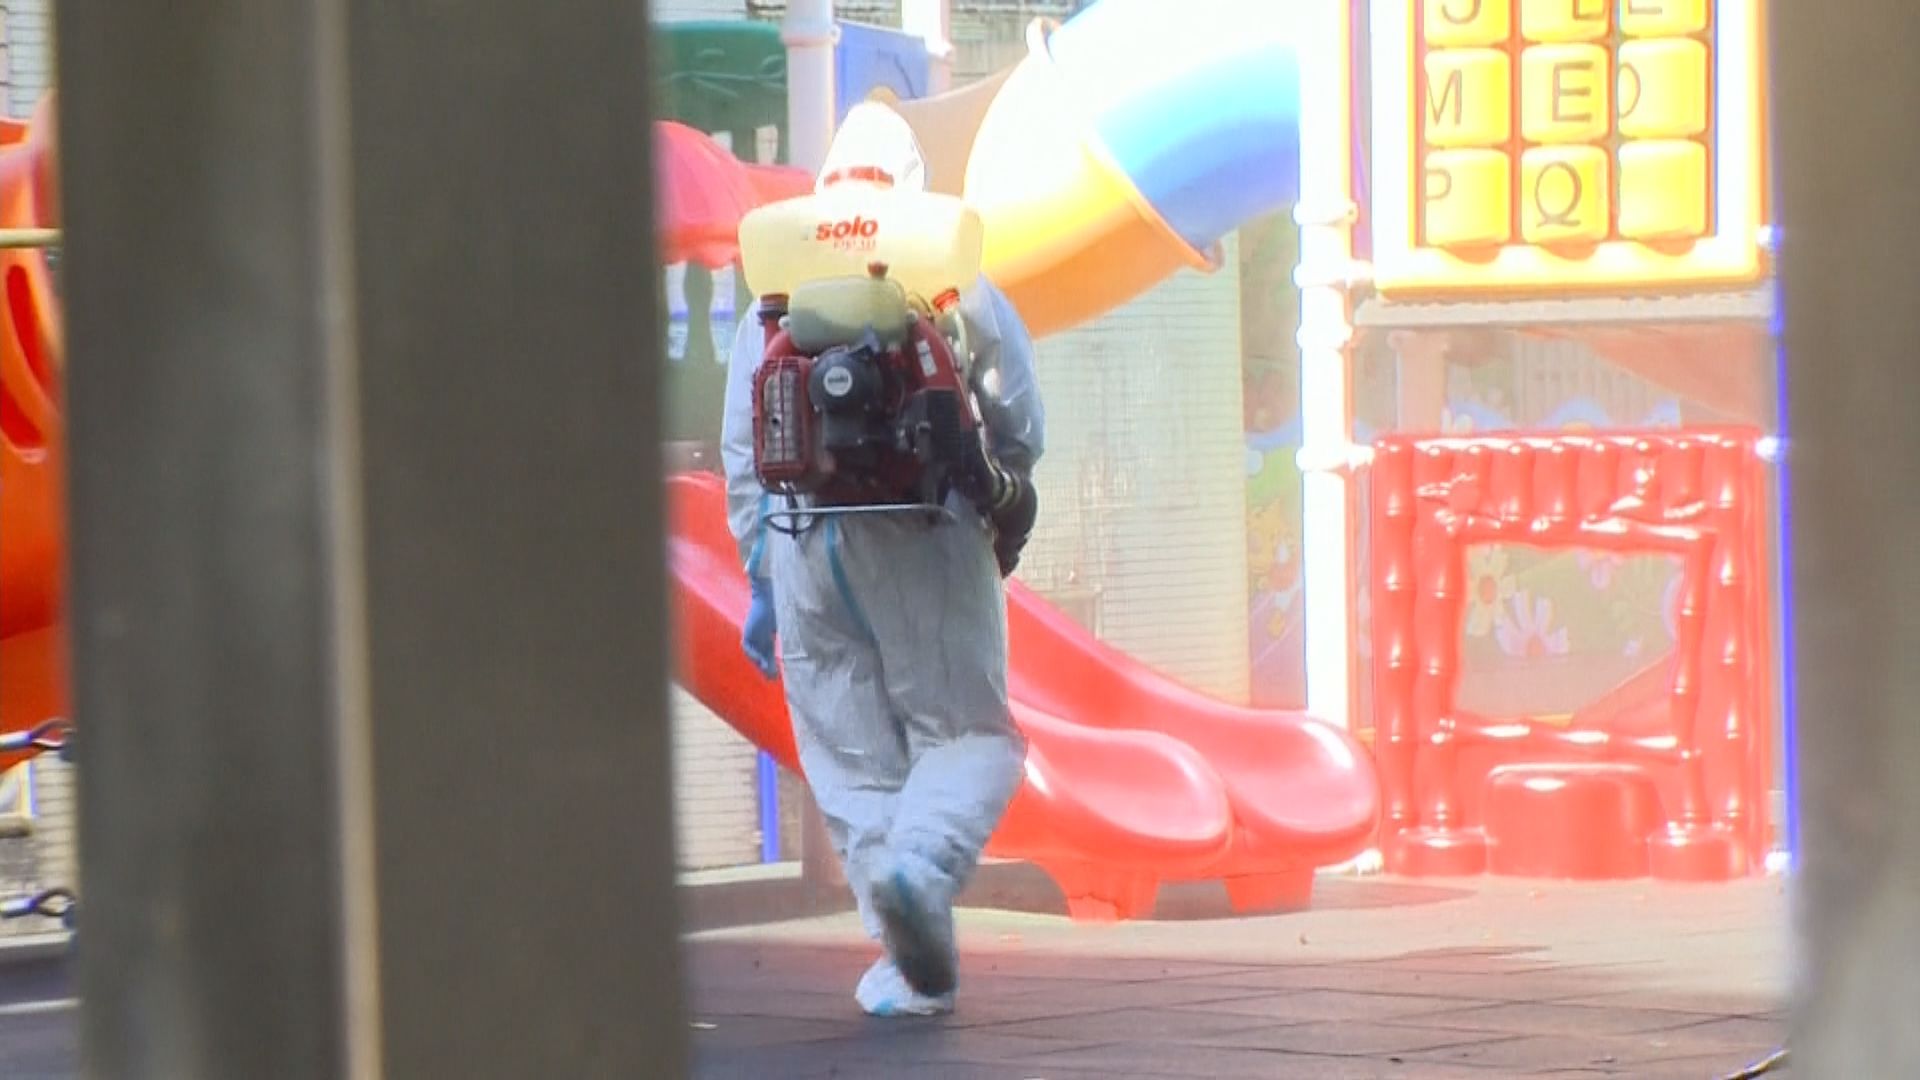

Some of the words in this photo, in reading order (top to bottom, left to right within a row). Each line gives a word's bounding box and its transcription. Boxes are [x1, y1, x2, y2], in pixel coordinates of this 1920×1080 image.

[1552, 61, 1594, 122] E
[1535, 161, 1582, 228] Q
[815, 215, 879, 240] solo
